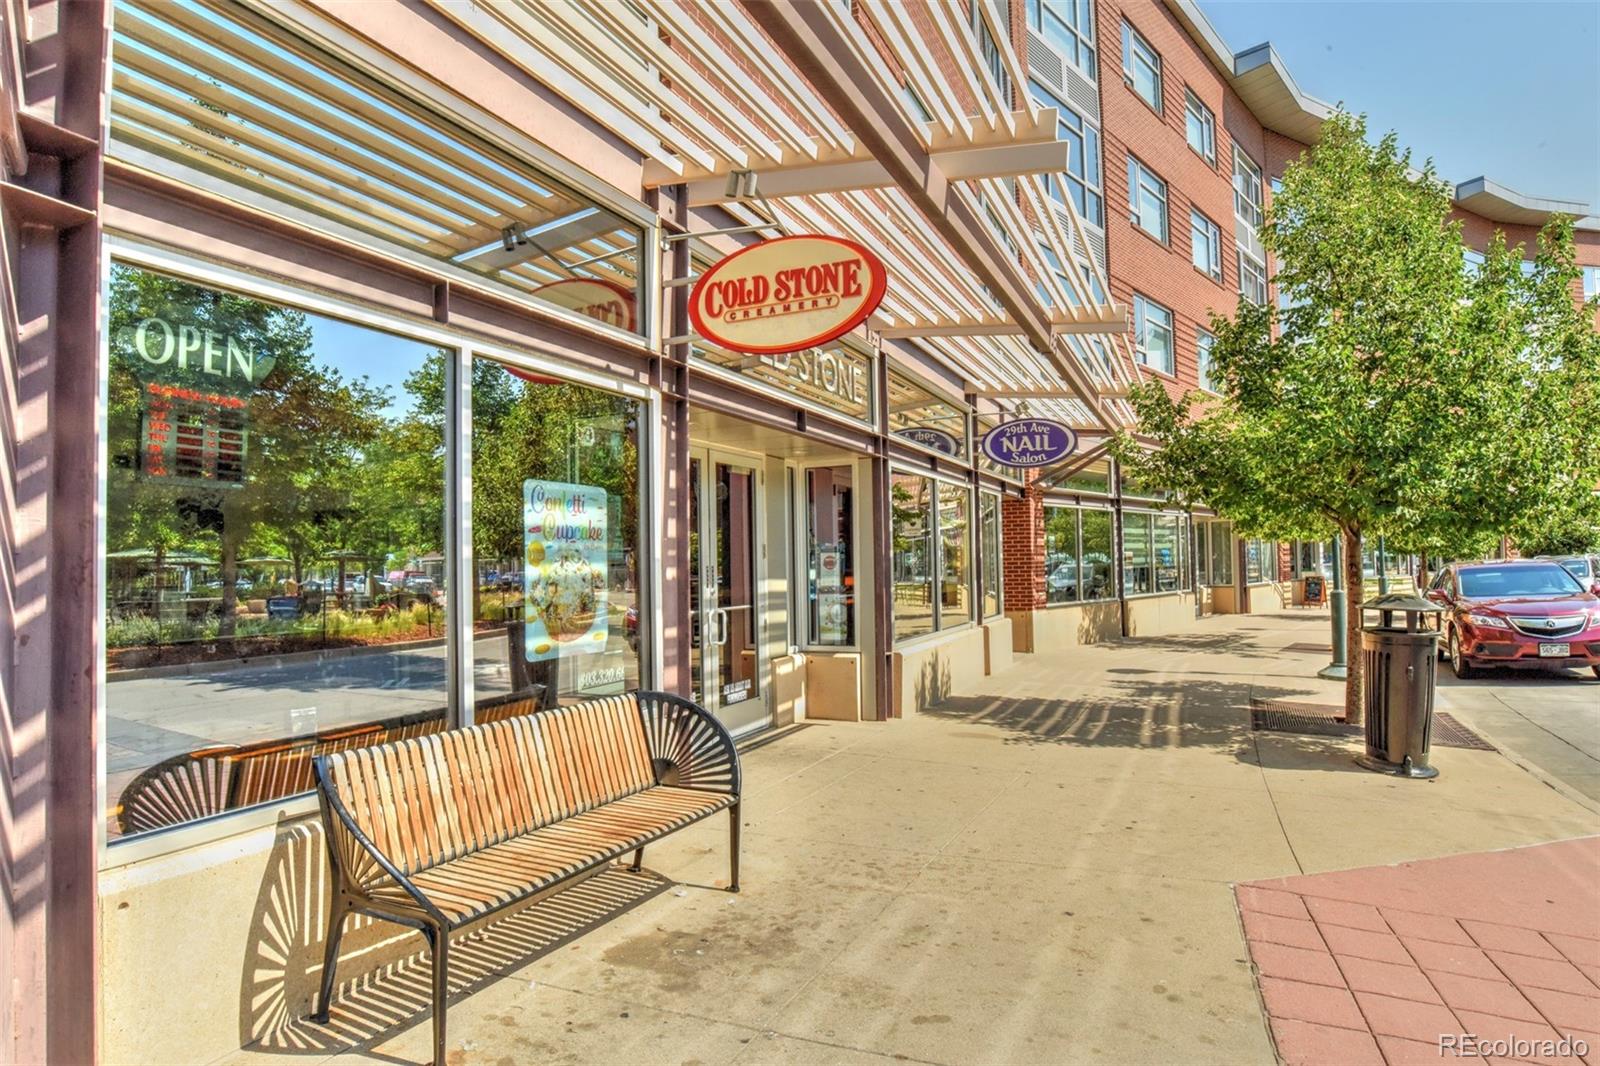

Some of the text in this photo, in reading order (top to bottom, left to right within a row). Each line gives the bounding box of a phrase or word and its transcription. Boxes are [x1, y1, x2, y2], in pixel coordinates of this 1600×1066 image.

[704, 258, 863, 319] COLD STONE
[729, 297, 834, 320] CREAMERY
[135, 317, 254, 382] OPEN
[1004, 422, 1050, 437] 29th Ave
[999, 434, 1059, 453] NAIL
[1011, 452, 1047, 463] Salon
[531, 485, 586, 520] Confetti
[543, 513, 603, 543] Cupcake
